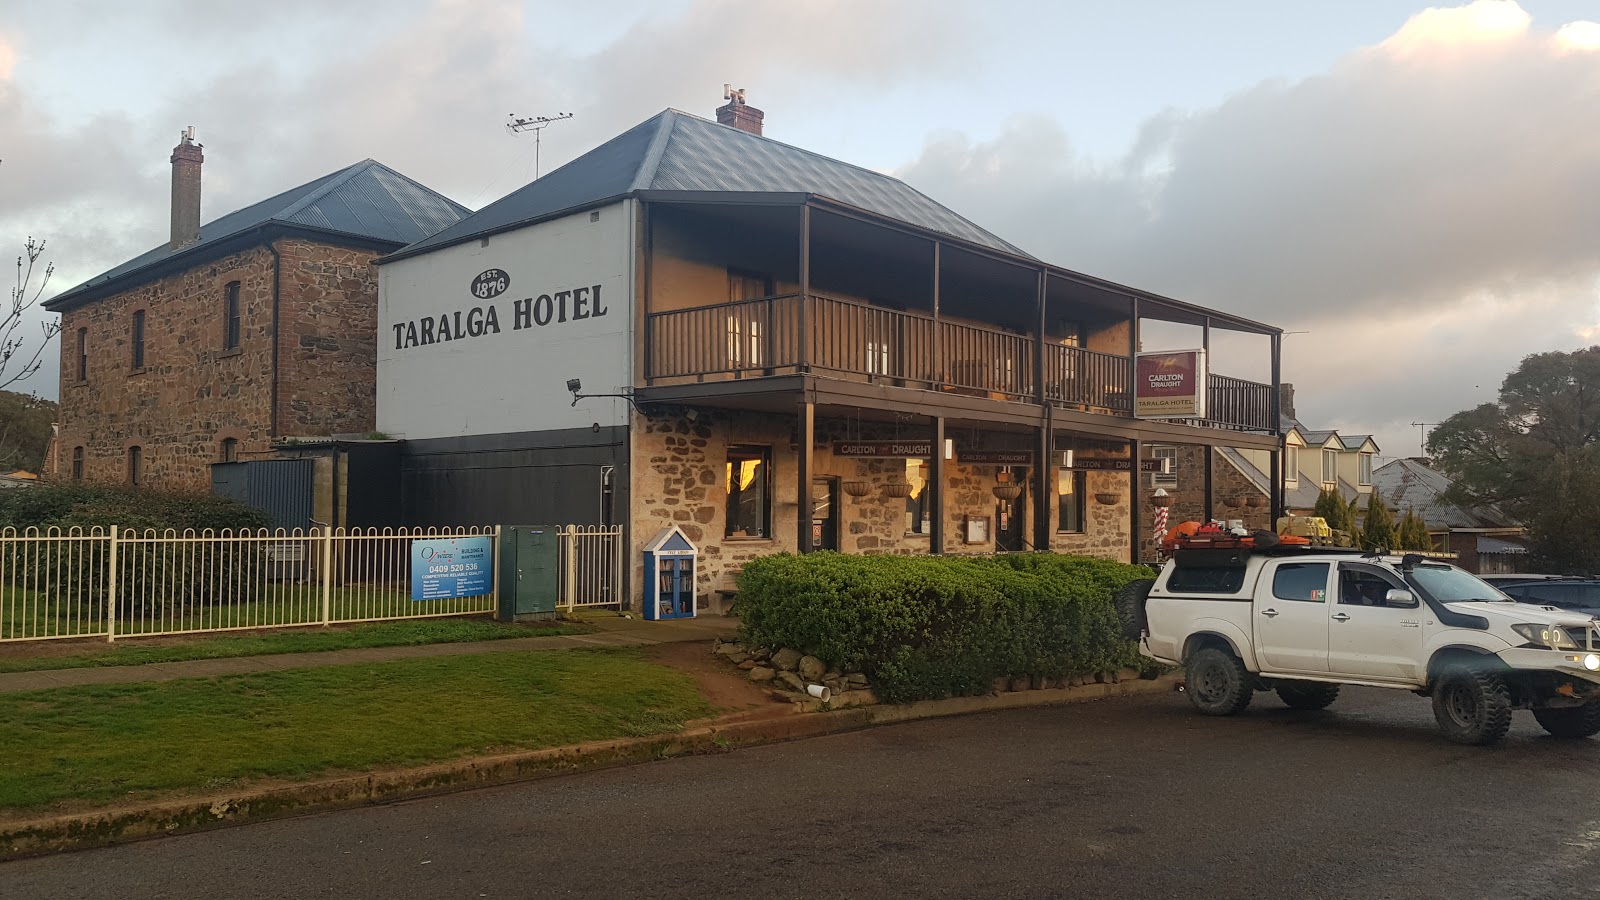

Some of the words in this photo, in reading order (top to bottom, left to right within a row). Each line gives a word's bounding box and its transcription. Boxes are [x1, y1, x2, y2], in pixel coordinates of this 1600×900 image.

[480, 270, 498, 281] EST.
[475, 277, 505, 298] 1876
[392, 305, 500, 350] TARALGA
[513, 284, 608, 330] HOTEL
[1148, 373, 1184, 382] CARLTON
[1150, 380, 1181, 388] DRAUGHT
[841, 444, 876, 454] CARLTON
[892, 444, 931, 454] DRAUGHT
[961, 454, 987, 462] CARLTON
[998, 454, 1027, 462] DRAUGHT
[1073, 460, 1101, 468] ARLTON
[1115, 461, 1154, 470] DRAHT
[429, 565, 449, 574] 0409
[450, 564, 464, 572] 520
[465, 563, 478, 571] 536
